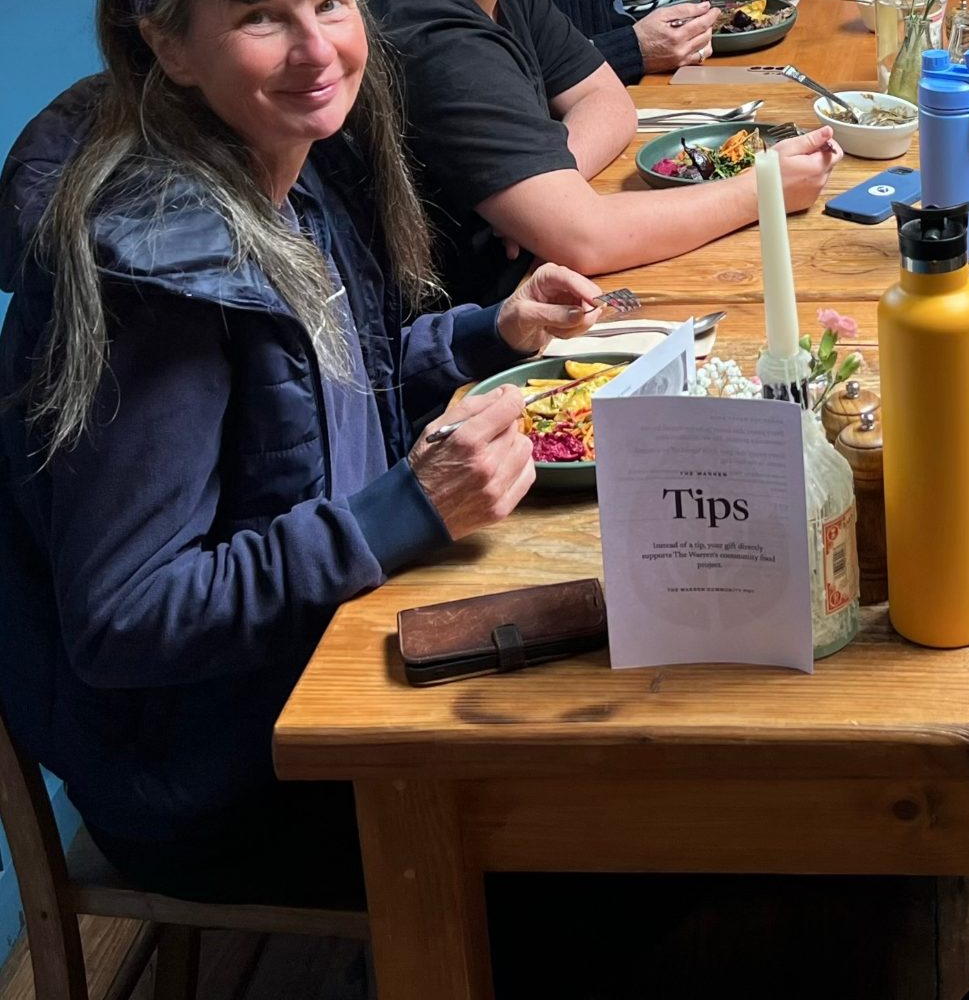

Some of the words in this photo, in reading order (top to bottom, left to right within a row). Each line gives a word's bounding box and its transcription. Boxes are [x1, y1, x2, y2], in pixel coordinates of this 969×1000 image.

[663, 488, 749, 528] Tips
[653, 541, 678, 549] Instead
[694, 541, 706, 550] tip,
[724, 541, 737, 551] gift
[737, 542, 763, 553] directly
[642, 552, 672, 560] supports
[719, 552, 759, 561] community
[760, 553, 776, 562] food
